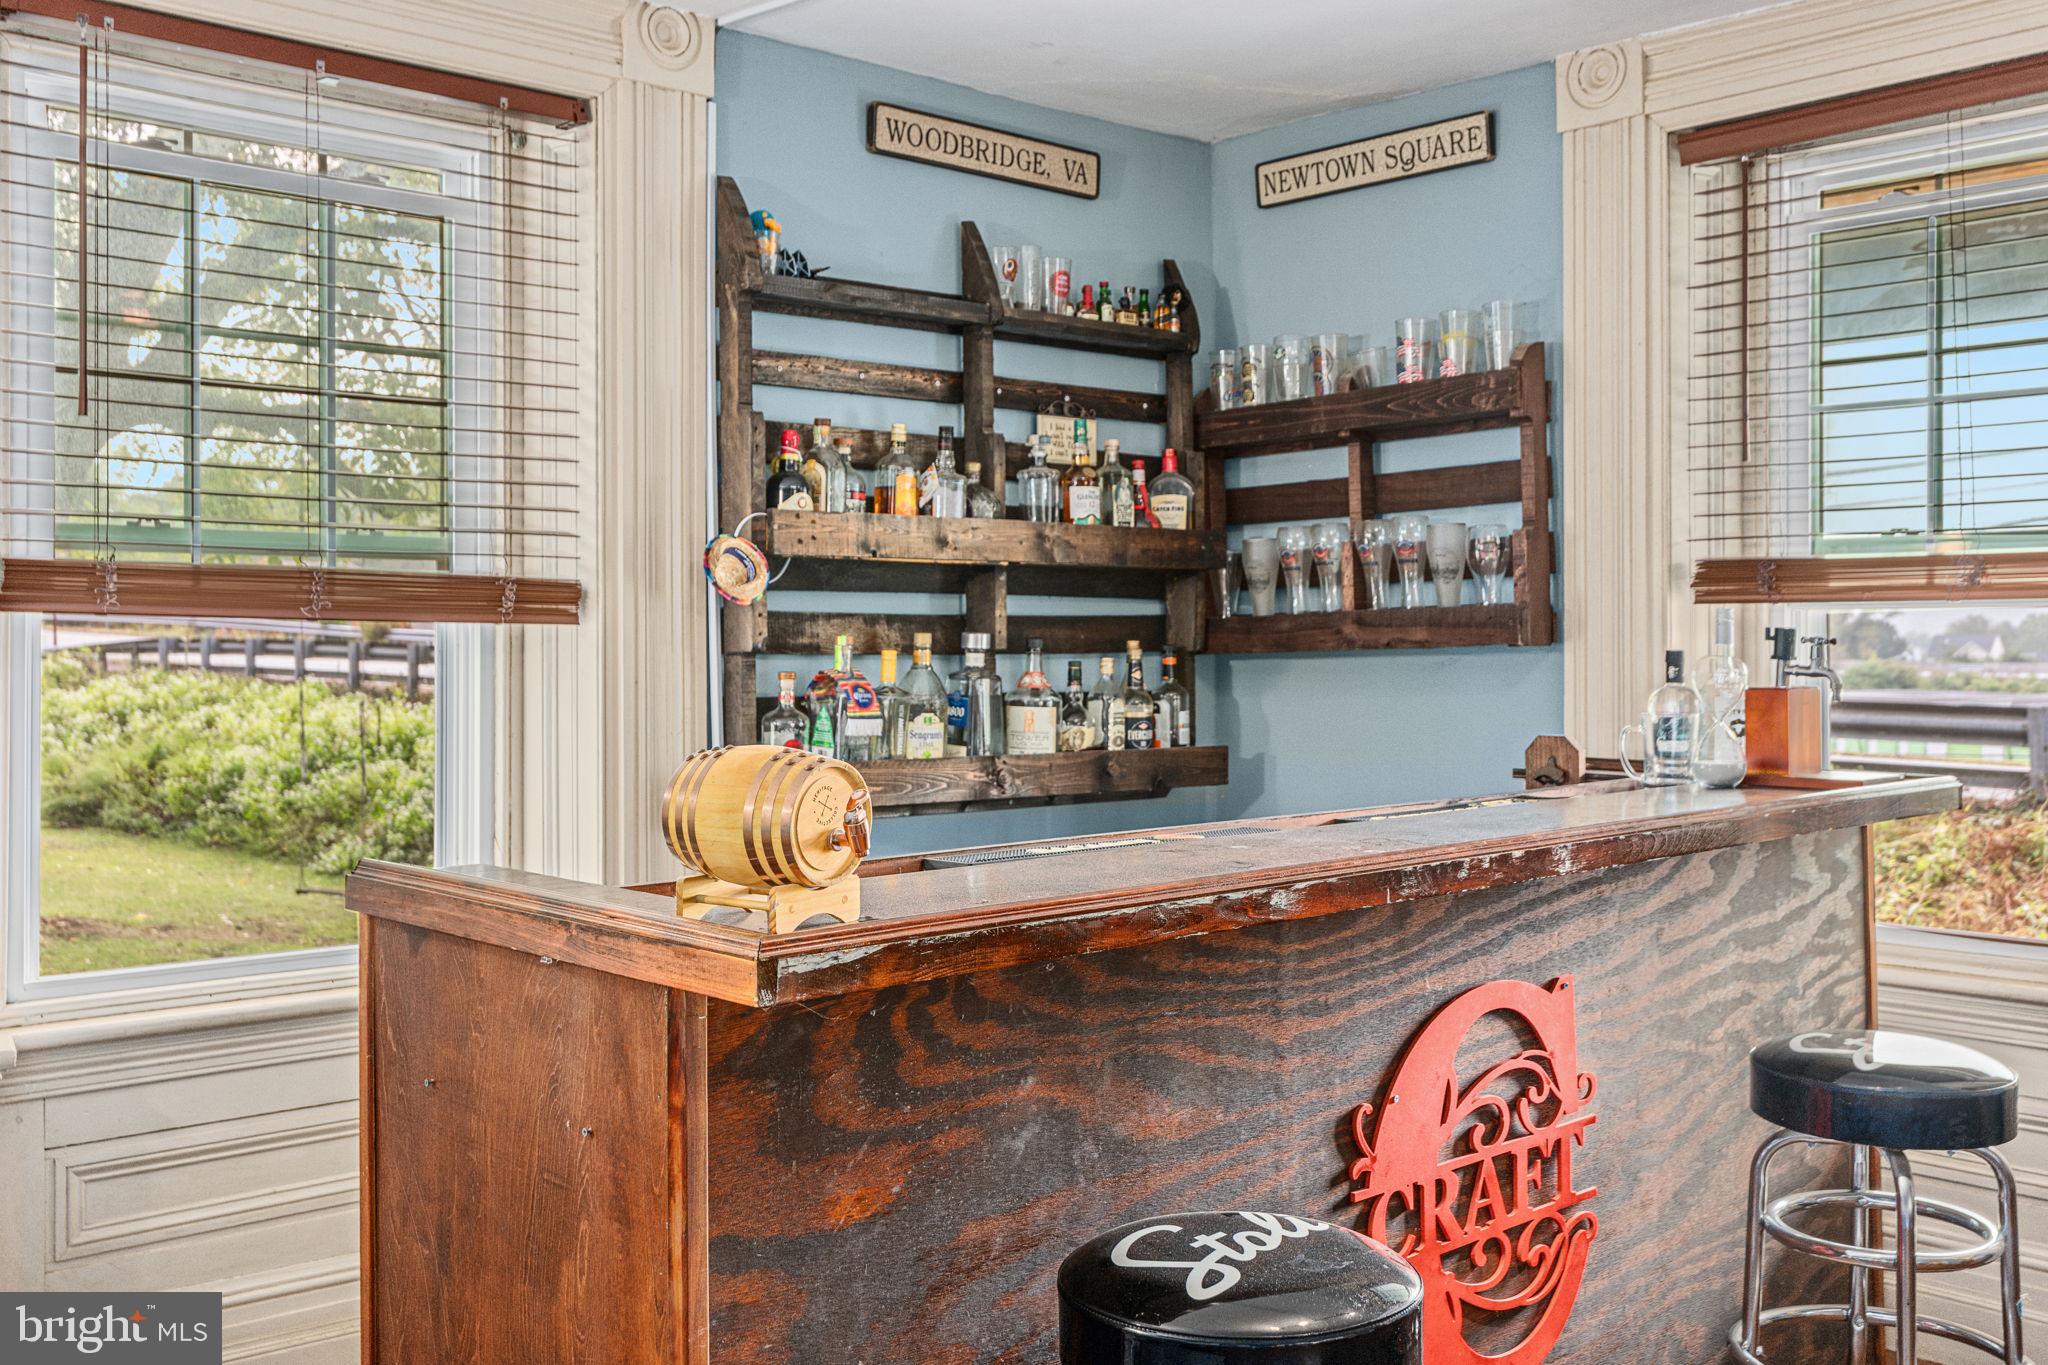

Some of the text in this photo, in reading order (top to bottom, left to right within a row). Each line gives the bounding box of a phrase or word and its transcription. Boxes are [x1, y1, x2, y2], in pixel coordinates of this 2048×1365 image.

[886, 117, 1089, 185] WOODBRIDGE, VA
[1263, 126, 1483, 197] NEWTOWN SQUARE
[1366, 1120, 1594, 1258] CRAFT
